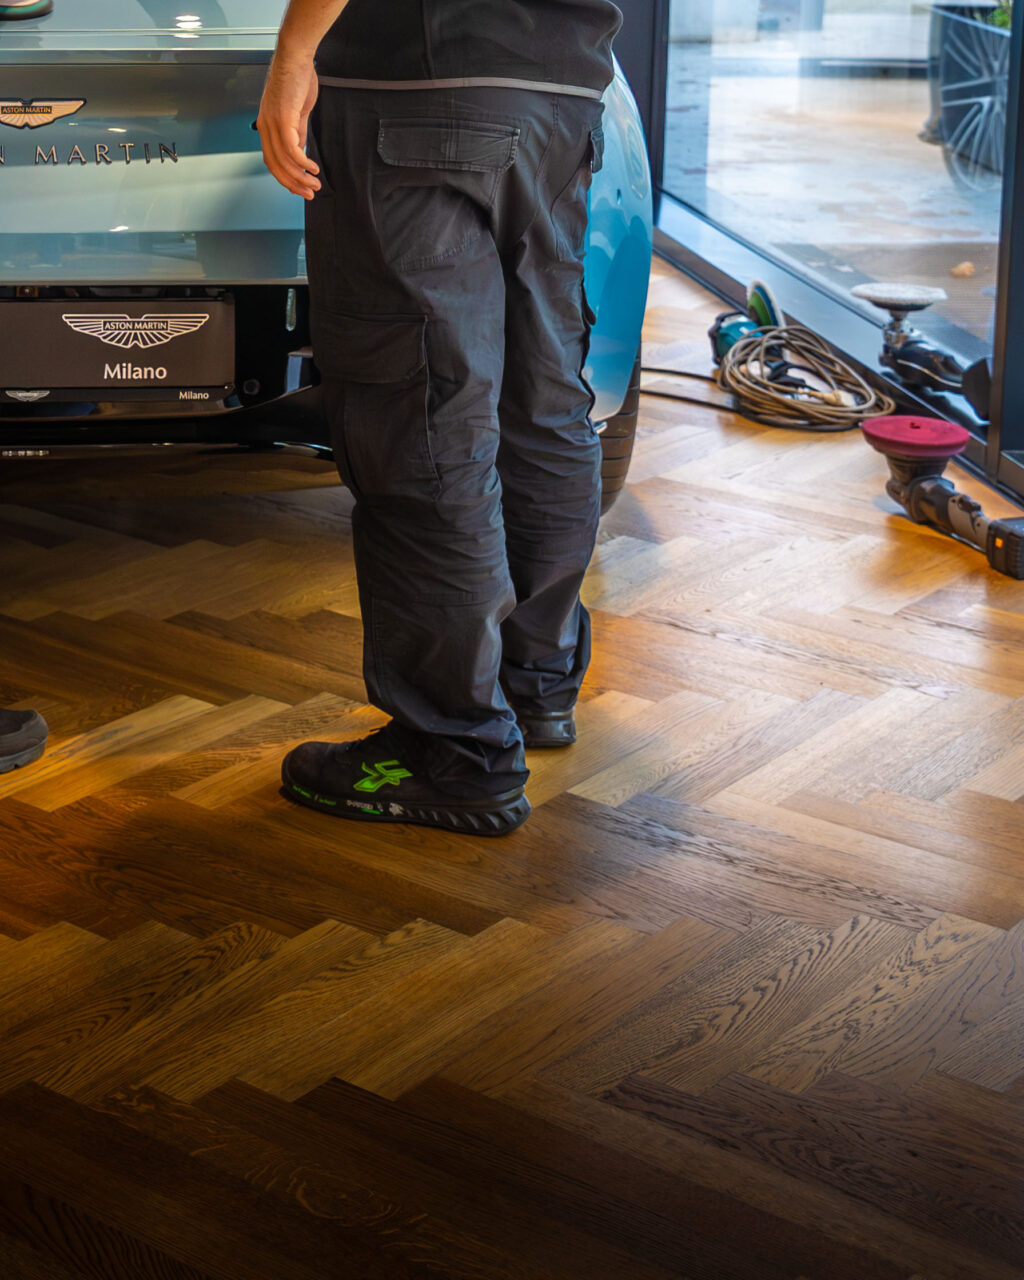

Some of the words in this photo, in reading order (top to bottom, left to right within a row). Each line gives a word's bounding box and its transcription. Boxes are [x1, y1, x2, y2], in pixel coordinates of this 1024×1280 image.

[34, 143, 179, 165] MARTIN
[104, 321, 134, 330] ASTON
[134, 321, 167, 330] MARTIN
[103, 363, 168, 379] Milano
[179, 391, 210, 400] Milano
